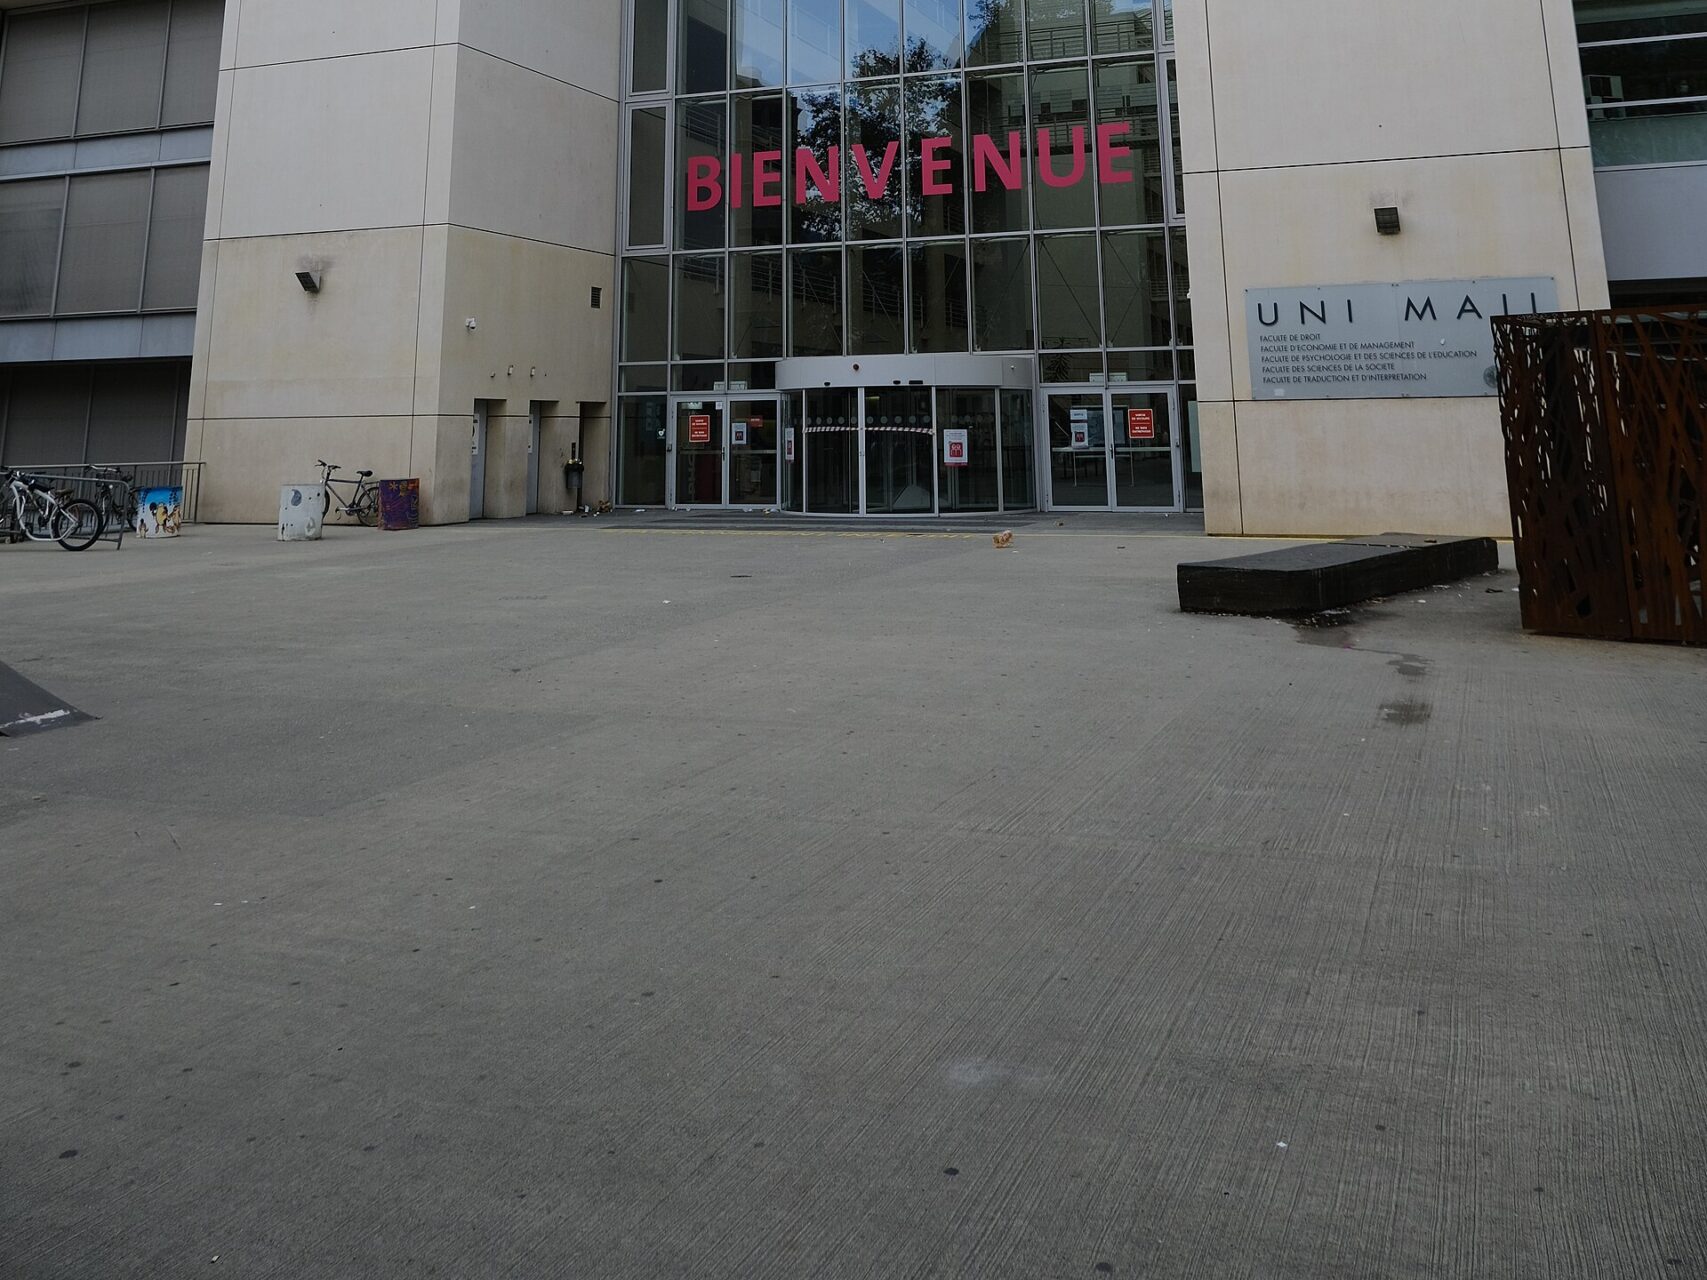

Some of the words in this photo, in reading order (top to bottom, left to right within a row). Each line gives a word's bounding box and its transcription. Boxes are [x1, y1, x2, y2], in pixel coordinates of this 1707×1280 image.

[686, 121, 1134, 212] BIENVENUE
[1257, 299, 1353, 326] UNI
[1259, 334, 1287, 342] FACULTE
[1300, 333, 1321, 341] DROIT
[1260, 344, 1288, 352] FACULTE
[1360, 340, 1415, 350] MANAGEMENT
[1261, 355, 1289, 363] FACULTE
[1291, 354, 1300, 362] DE
[1302, 353, 1352, 362] PSYCHOLOGIE
[1363, 352, 1377, 360] DES
[1379, 351, 1415, 360] SCIENCES
[1416, 351, 1427, 359] DE
[1262, 366, 1290, 374] FACULTE
[1292, 365, 1305, 373] DES
[1306, 364, 1342, 372] SCIENCES
[1365, 362, 1395, 371] SOCIETE
[1304, 374, 1350, 383] TRADUCTION
